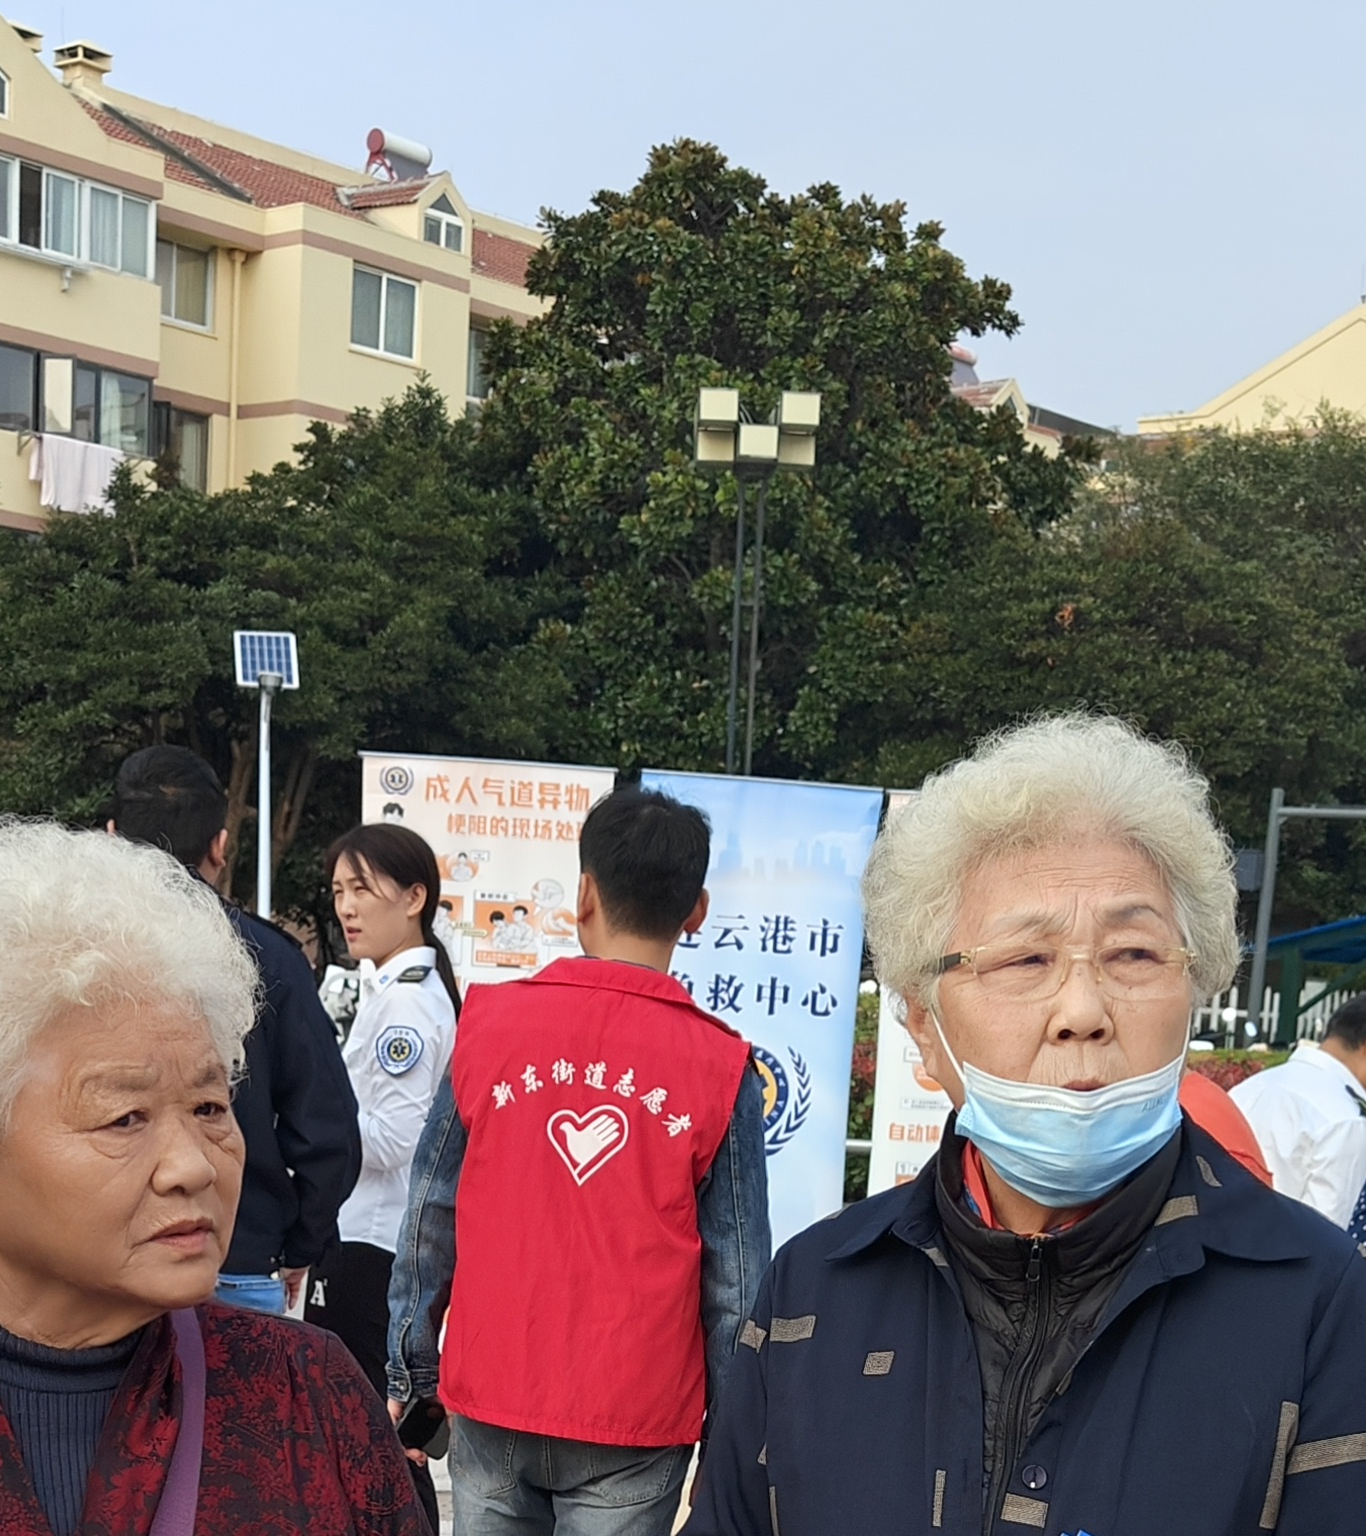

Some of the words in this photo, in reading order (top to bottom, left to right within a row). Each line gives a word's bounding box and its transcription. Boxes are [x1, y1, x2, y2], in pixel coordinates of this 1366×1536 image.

[425, 775, 591, 812] 成人气道异物
[447, 813, 581, 842] 梗阻的现场处
[491, 1058, 692, 1137] 新东街道志愿者
